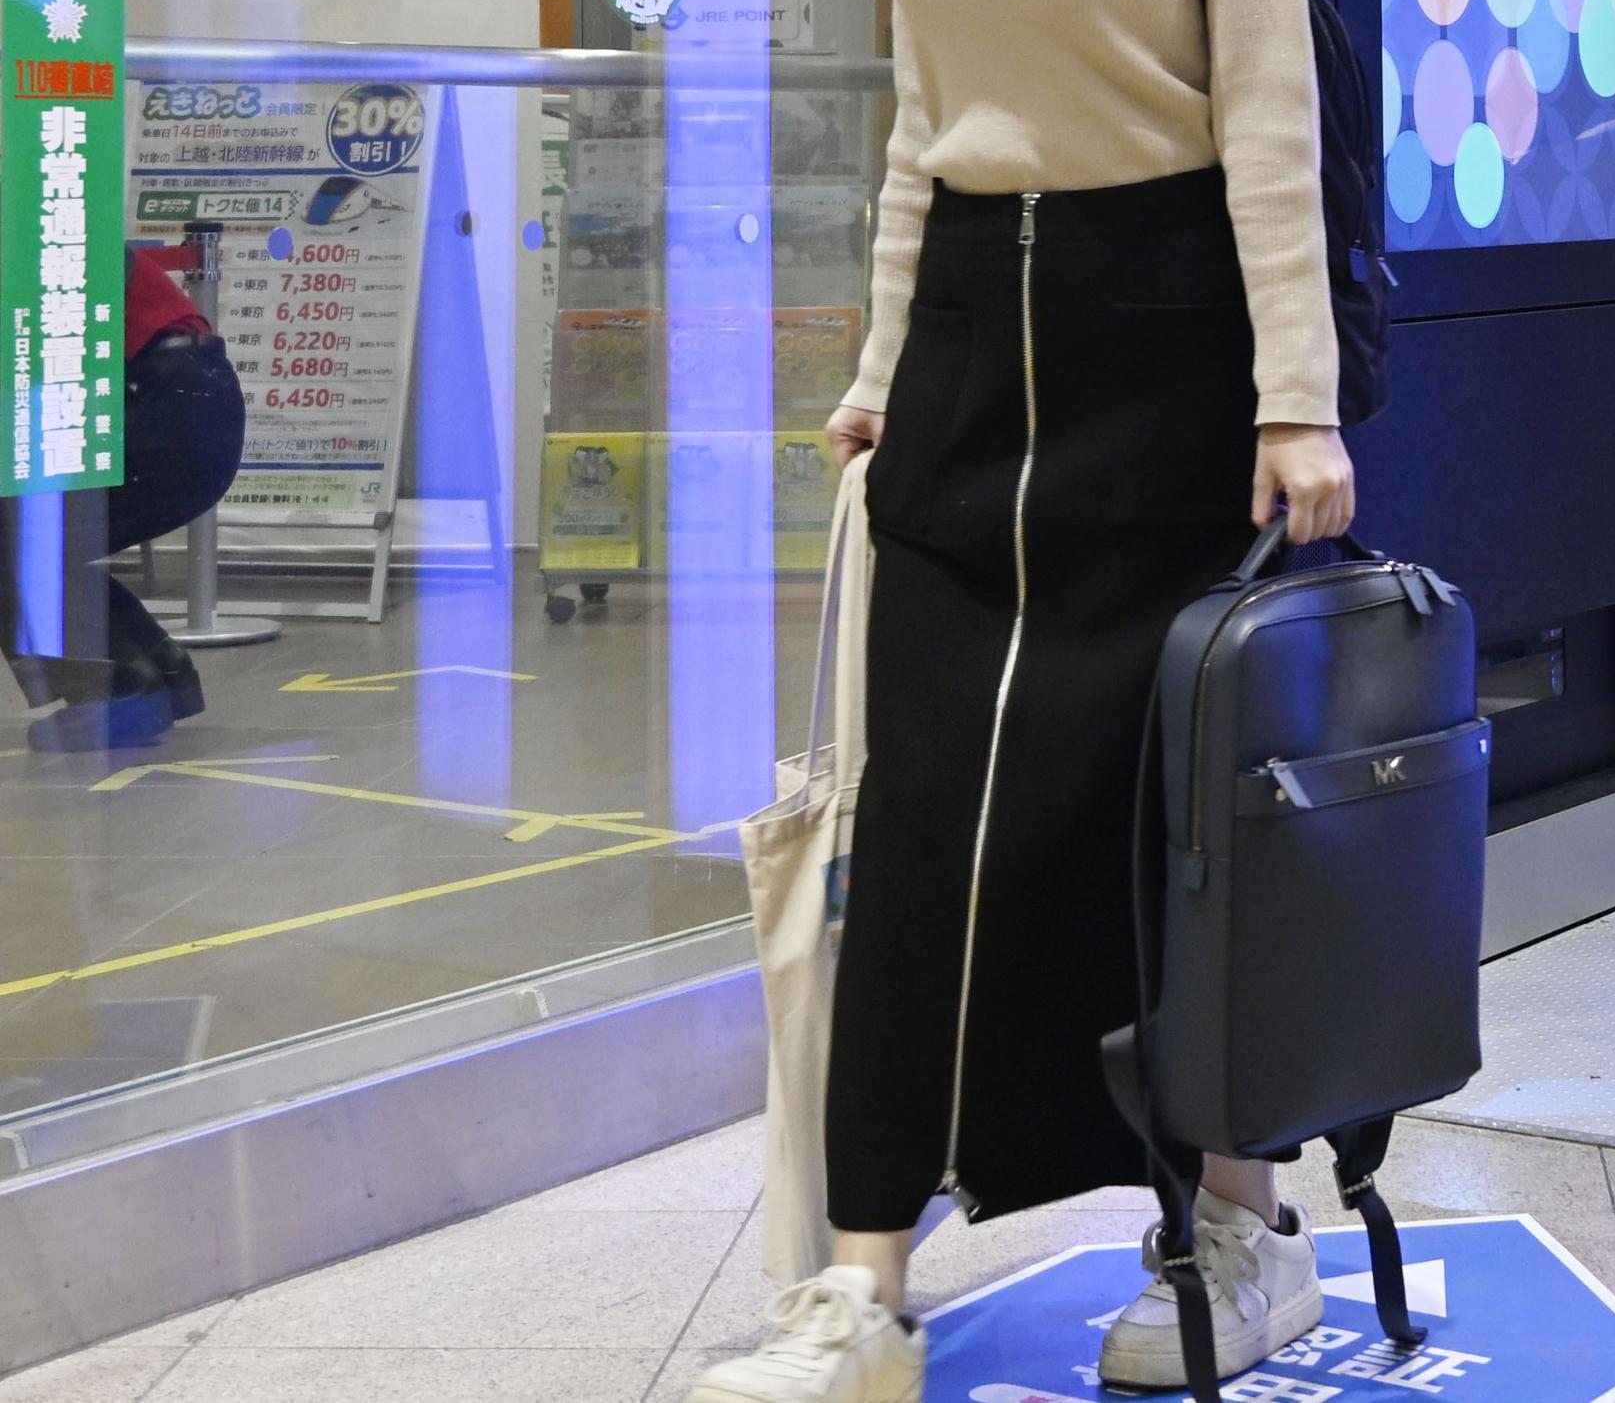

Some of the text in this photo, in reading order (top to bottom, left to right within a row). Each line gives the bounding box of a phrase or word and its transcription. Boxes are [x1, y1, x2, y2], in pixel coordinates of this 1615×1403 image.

[735, 10, 786, 22] POINT
[332, 99, 423, 135] 30%
[288, 244, 360, 265] ,600円
[245, 279, 267, 290] 東京
[241, 306, 264, 319] 東京
[238, 334, 262, 346] 東京
[236, 361, 260, 373] 東京
